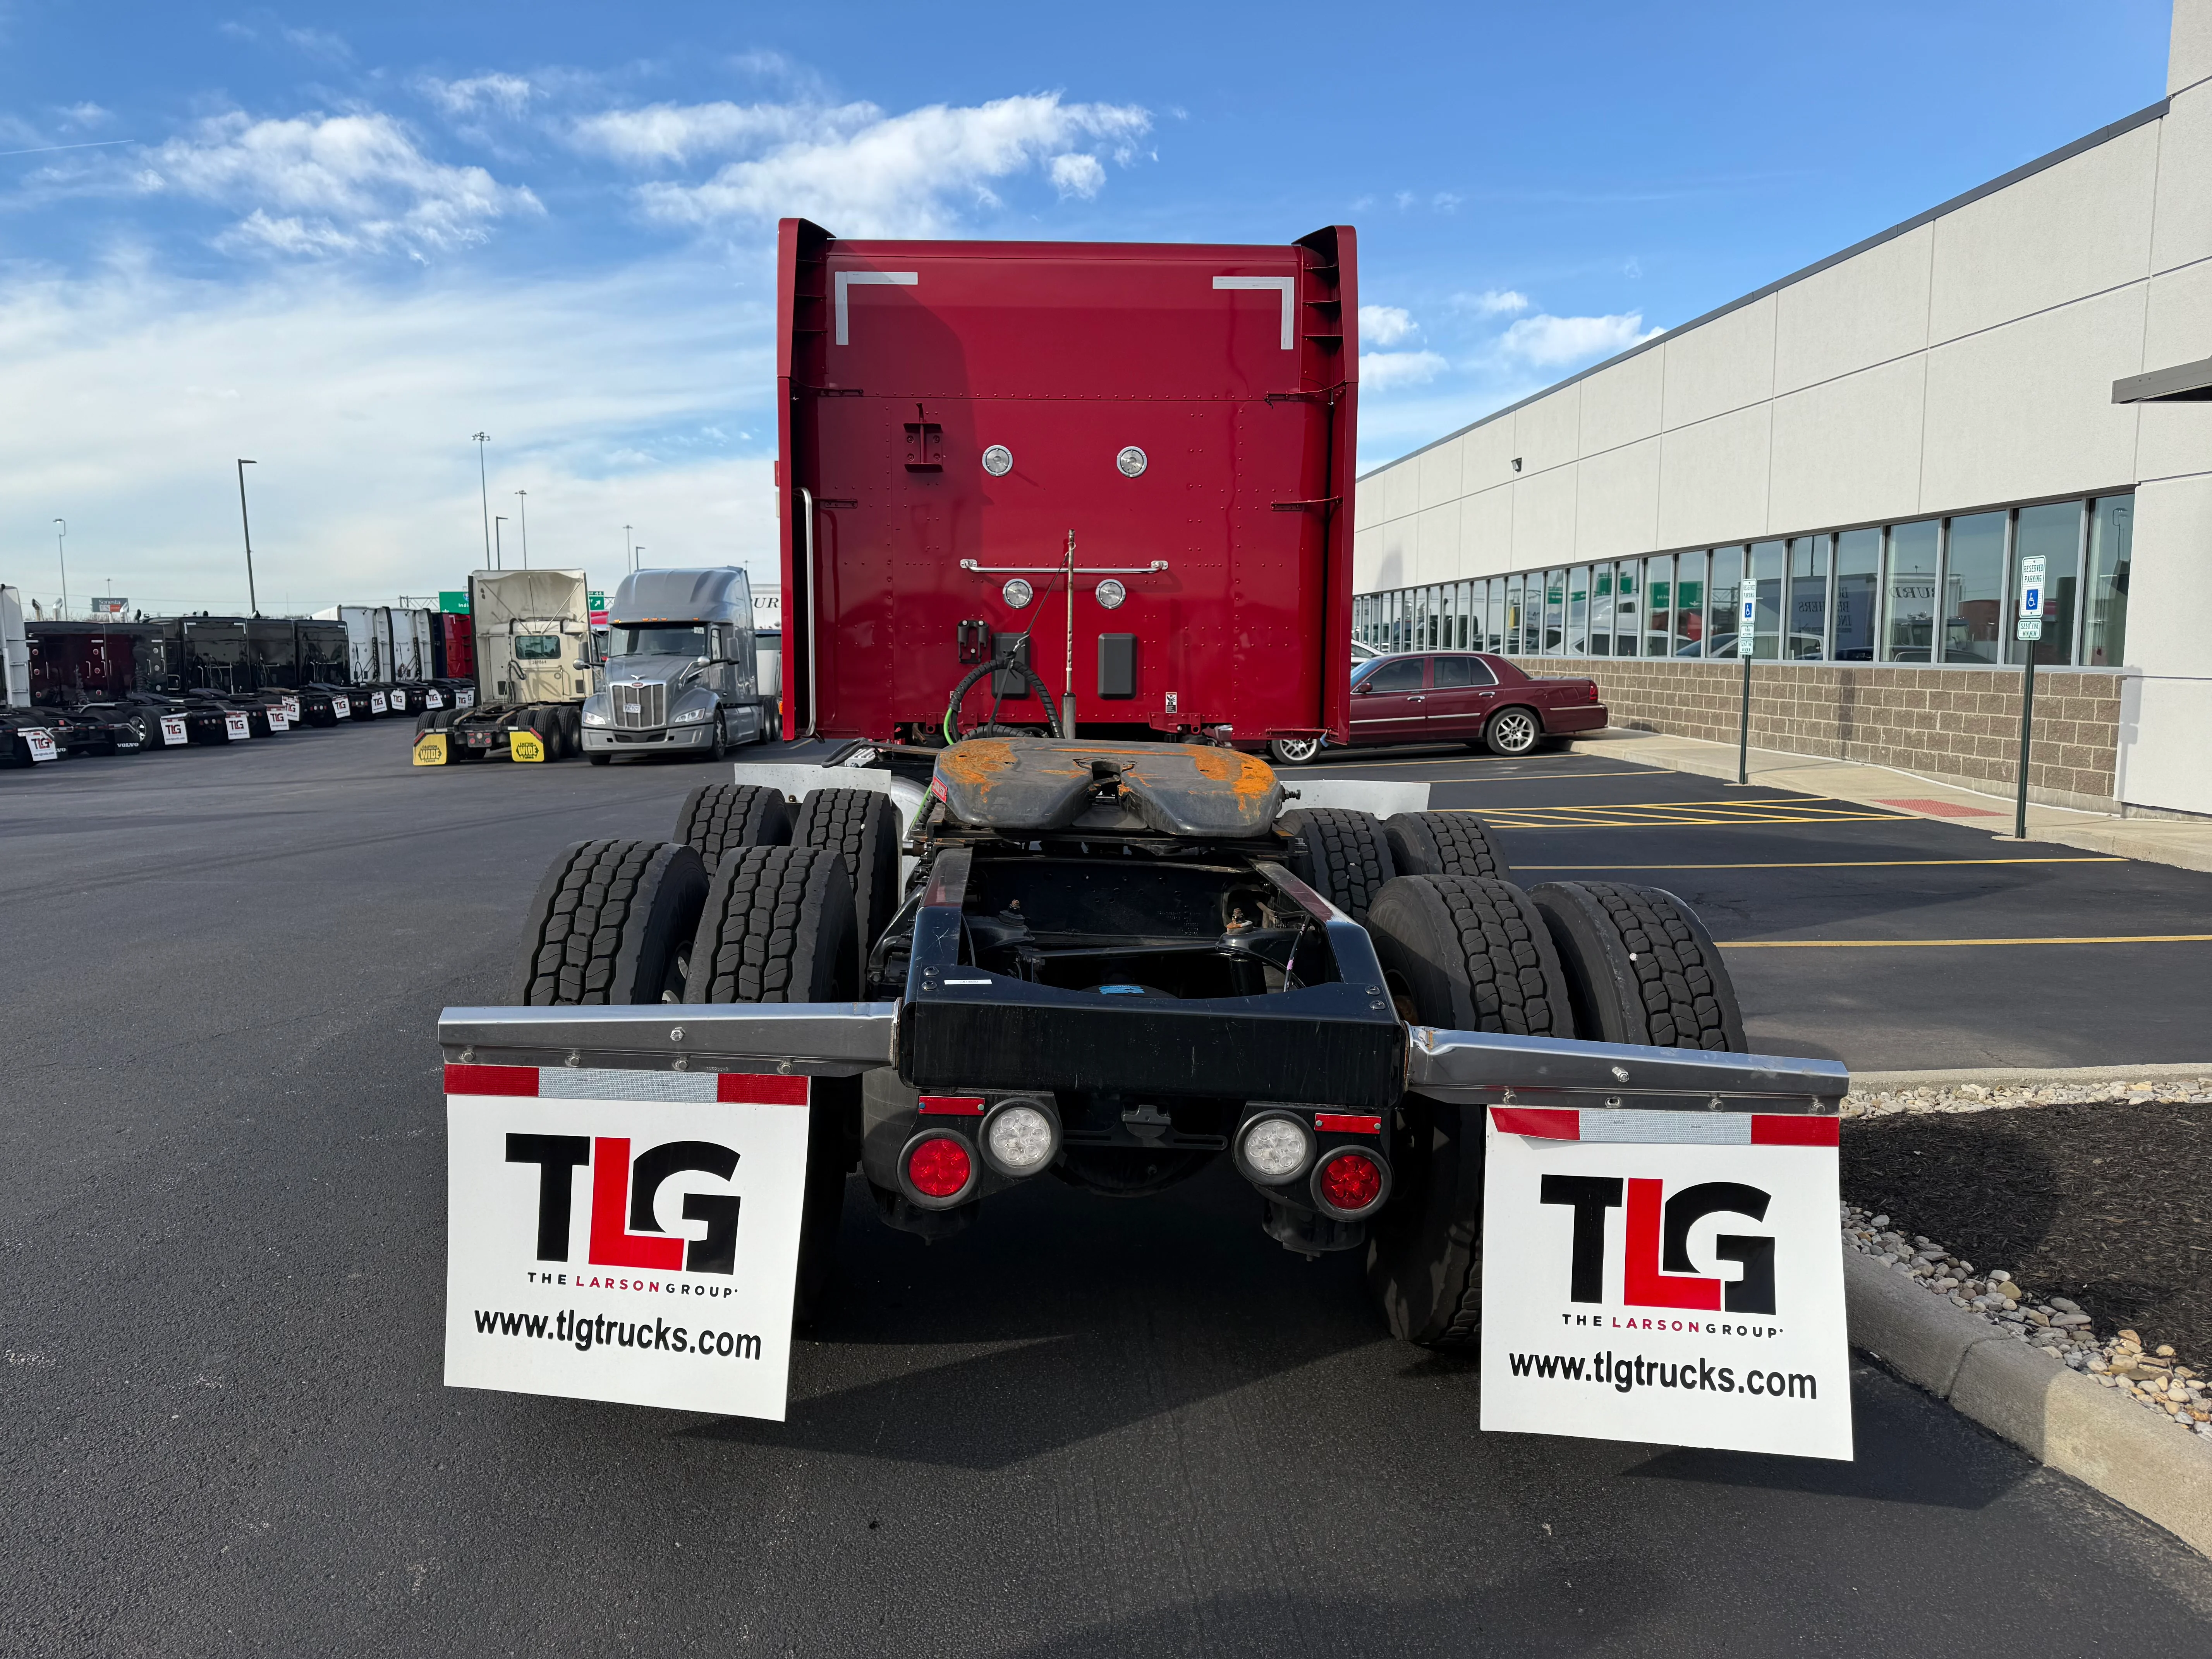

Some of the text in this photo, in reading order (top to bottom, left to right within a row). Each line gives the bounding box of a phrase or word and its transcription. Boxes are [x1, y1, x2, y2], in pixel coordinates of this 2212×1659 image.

[2024, 564, 2043, 572] RESERVED
[752, 597, 781, 608] UR
[285, 702, 296, 712] TLG
[335, 701, 346, 709] TLG
[373, 697, 383, 706] TLG
[270, 713, 284, 722] TLG
[165, 724, 181, 735] TLG
[229, 720, 244, 730] TLG
[31, 737, 50, 750] TLG
[420, 749, 440, 759] WIDE
[518, 746, 537, 755] WIDE
[505, 1133, 740, 1275] TLG
[1540, 1174, 1776, 1315] TLG
[528, 1273, 732, 1298] THE LARSON GROUP
[1563, 1314, 1776, 1338] THE LARSON GROUP
[475, 1310, 761, 1360] www.tlgtrucks.com
[1510, 1351, 1816, 1399] www.tlgtrucks.com
